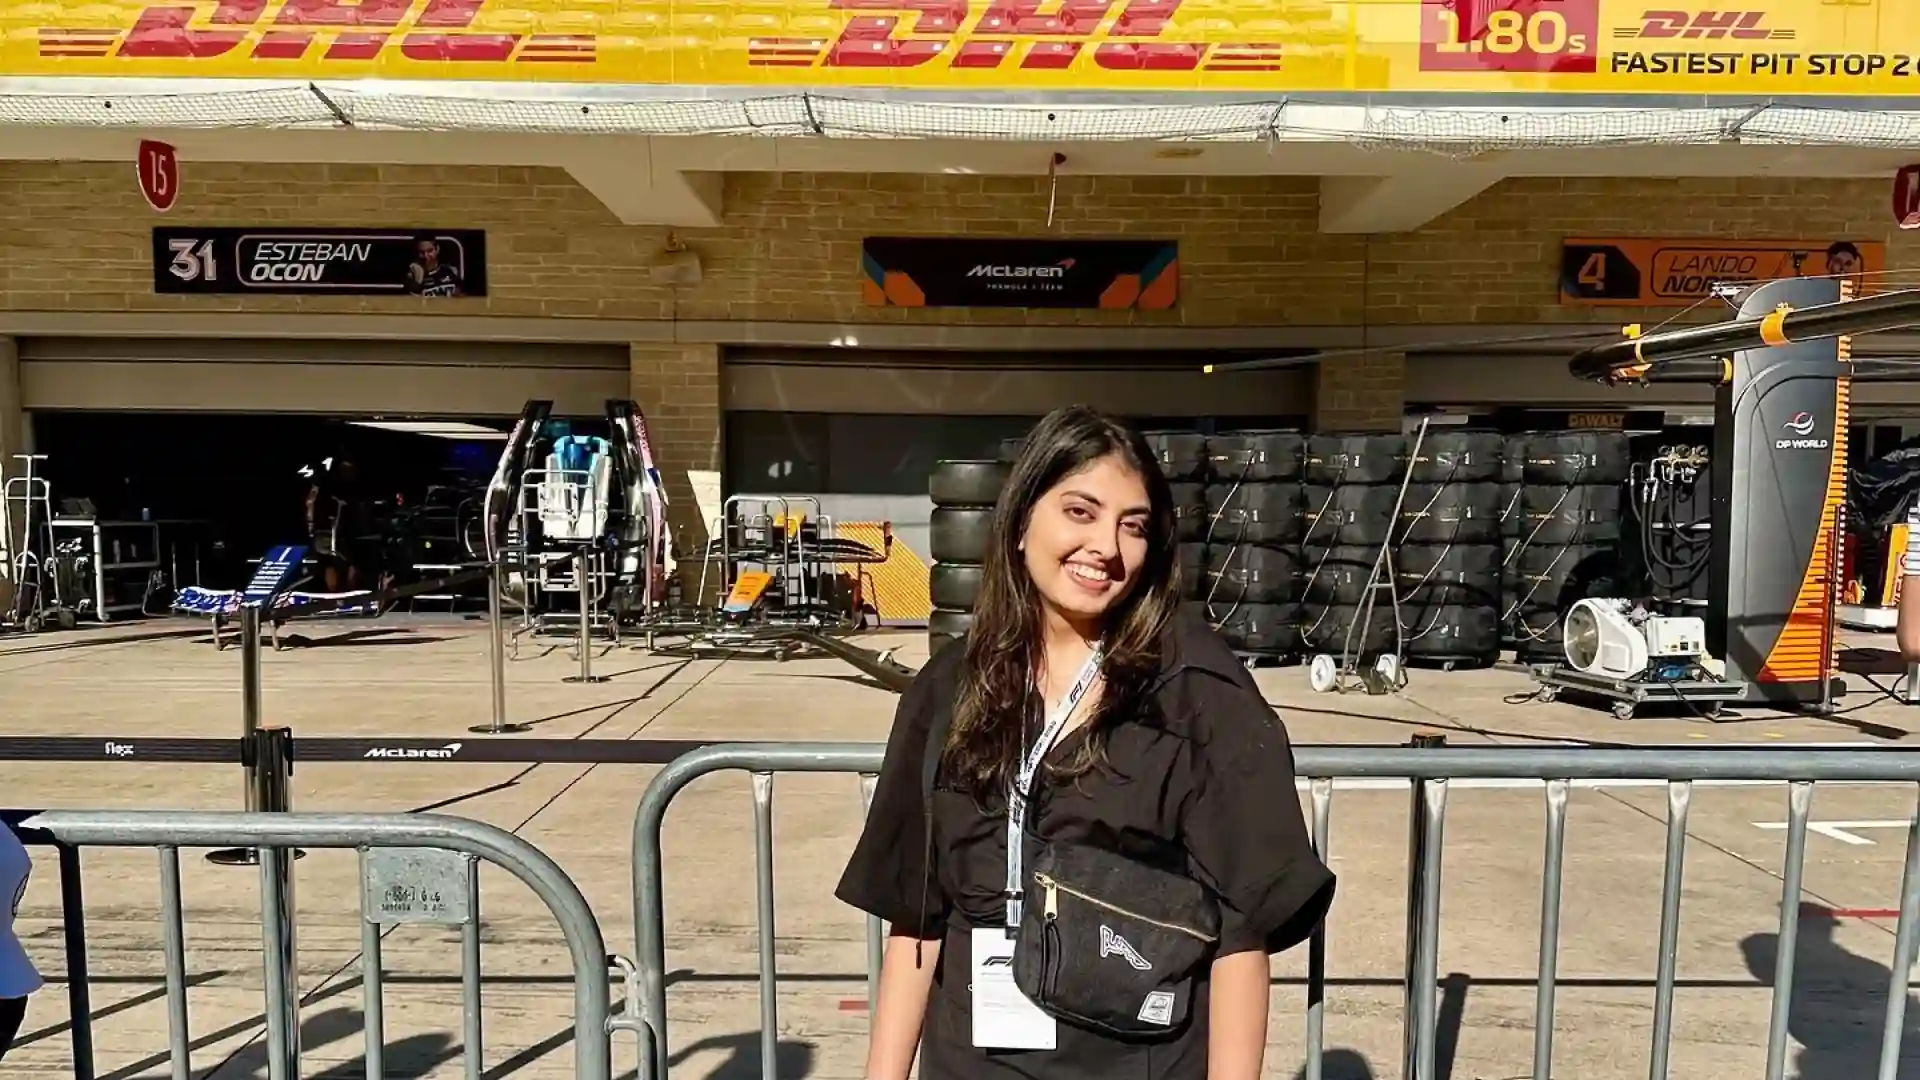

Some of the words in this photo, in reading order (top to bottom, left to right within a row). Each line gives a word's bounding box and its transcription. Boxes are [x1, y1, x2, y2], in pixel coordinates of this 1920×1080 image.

[116, 0, 522, 58] DHL
[820, 0, 1204, 70] DHL
[1637, 10, 1772, 40] DHL
[1611, 51, 1744, 74] FASTEST
[1750, 53, 1801, 75] PIT
[1807, 54, 1886, 76] STOP
[1891, 54, 1920, 77] 2
[149, 151, 168, 196] 15
[168, 238, 218, 281] 31
[254, 242, 372, 262] ESTEBAN
[1668, 255, 1758, 274] LANDO
[250, 262, 326, 282] OCON
[966, 264, 1064, 278] McLaren
[1577, 252, 1606, 291] 4
[1775, 440, 1791, 450] DP
[1791, 439, 1828, 450] WORLD
[364, 744, 454, 758] McLaren
